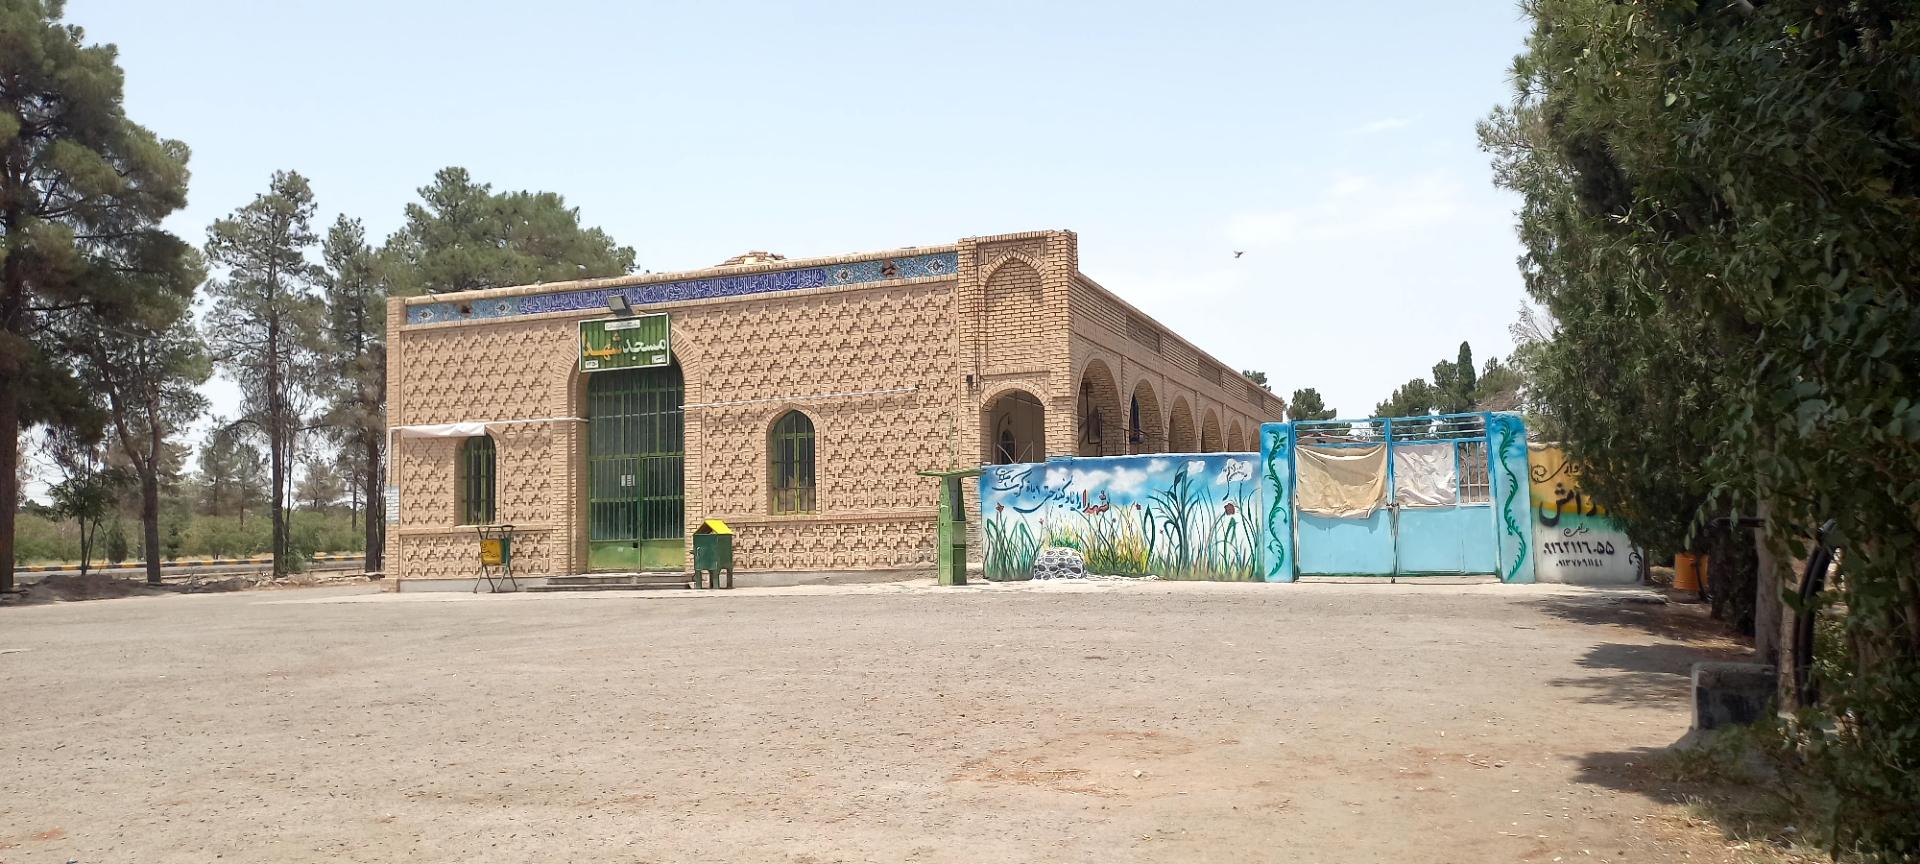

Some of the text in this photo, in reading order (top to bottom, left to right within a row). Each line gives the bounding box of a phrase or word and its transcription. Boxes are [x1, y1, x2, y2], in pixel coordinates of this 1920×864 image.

[582, 331, 666, 360] مسجد شهدا
[1053, 475, 1073, 508] کنید
[1082, 489, 1110, 515] شهدا
